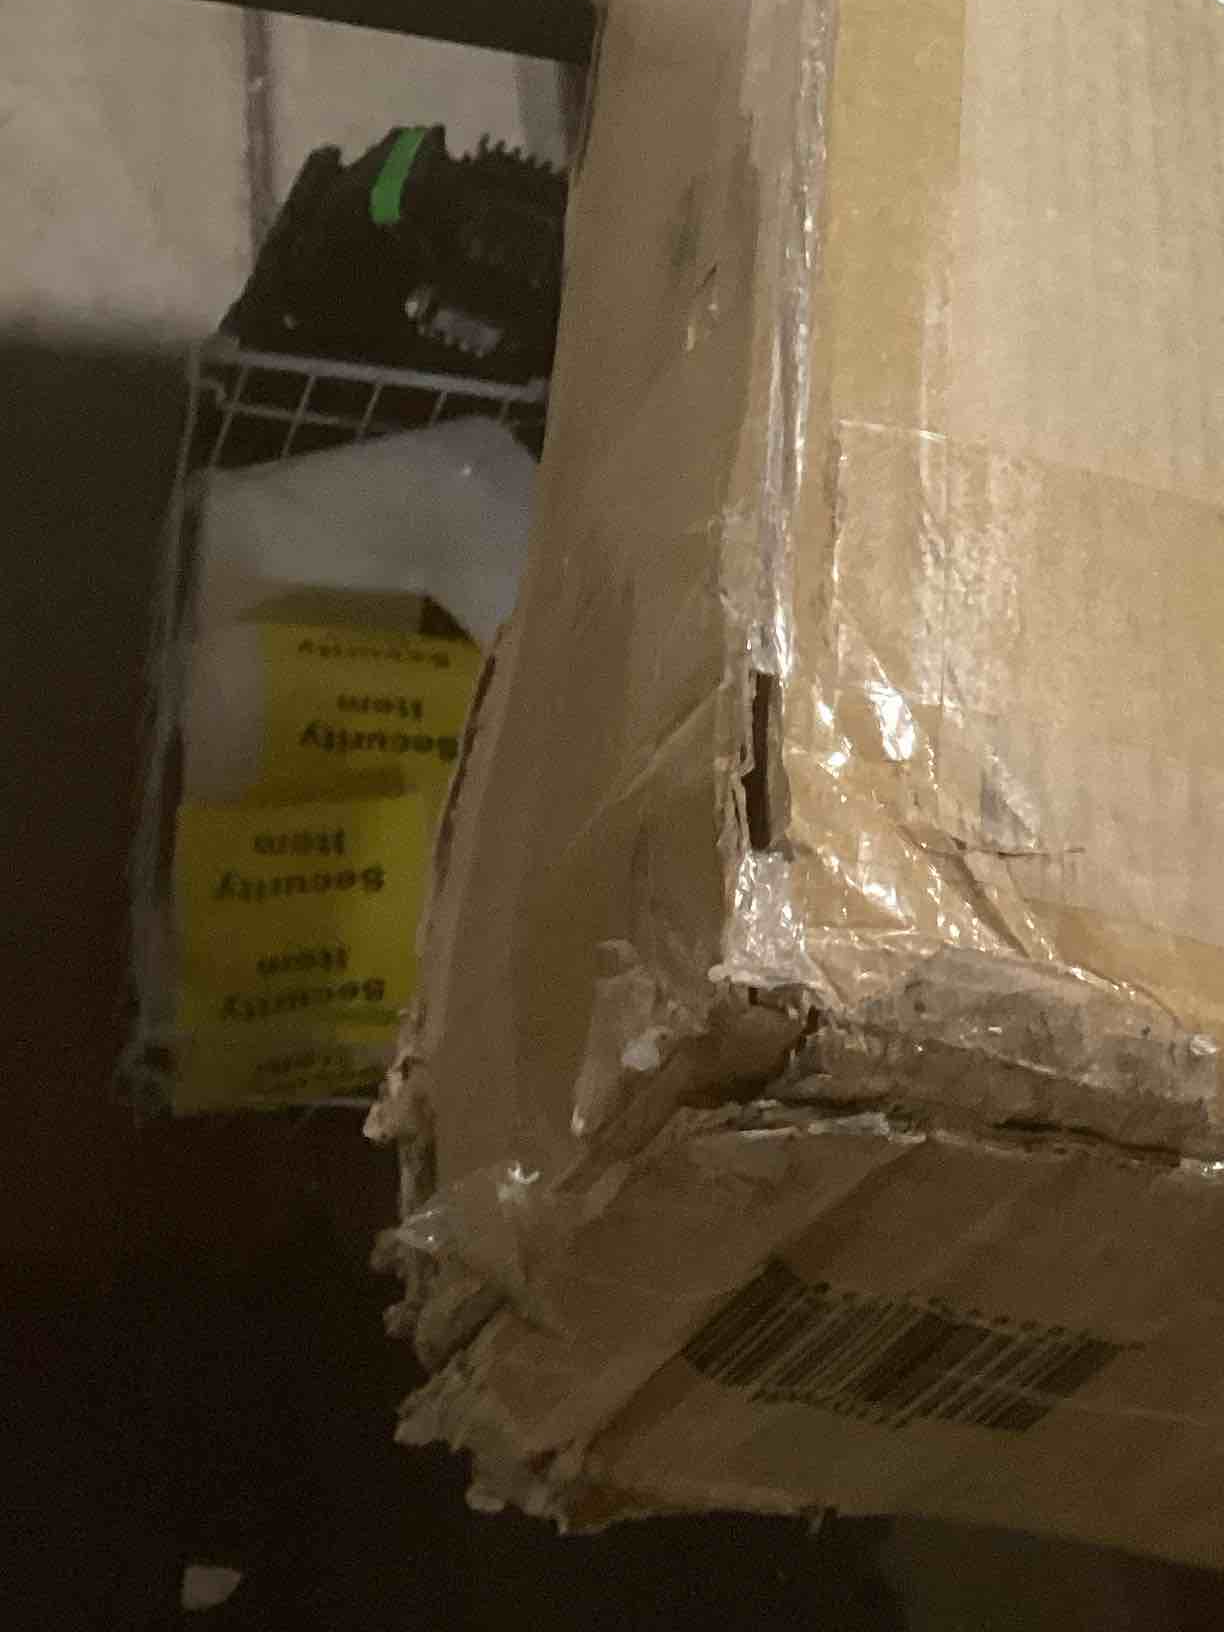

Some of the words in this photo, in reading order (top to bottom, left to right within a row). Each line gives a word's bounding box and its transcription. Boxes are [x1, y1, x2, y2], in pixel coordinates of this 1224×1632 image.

[298, 719, 461, 764] Security
[253, 827, 348, 859] Item
[211, 863, 387, 905] Security
[256, 945, 350, 977] Item
[221, 978, 387, 1023] Security
